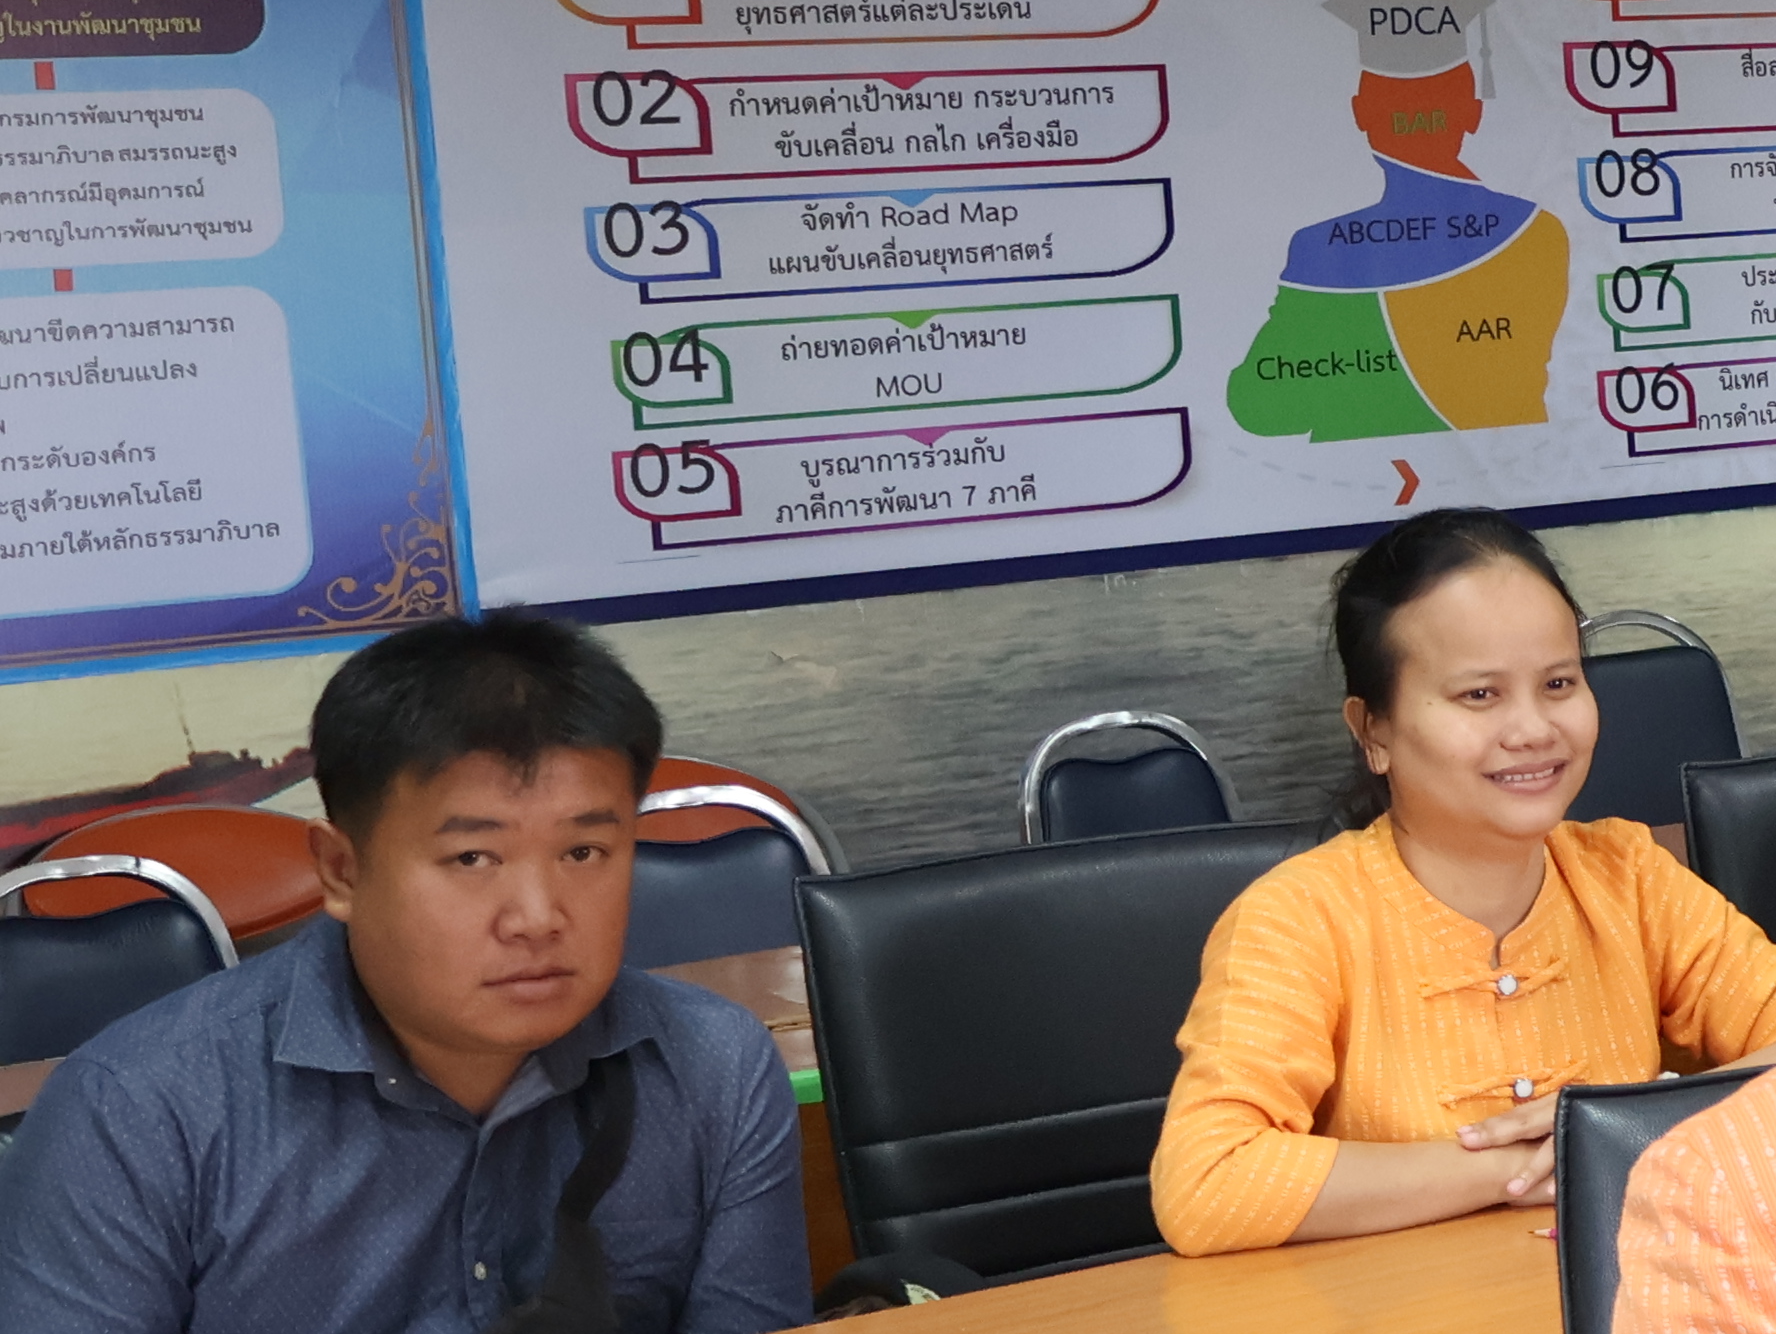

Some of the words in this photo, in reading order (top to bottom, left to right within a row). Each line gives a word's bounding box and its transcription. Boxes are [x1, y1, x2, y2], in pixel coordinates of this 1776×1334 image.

[1369, 6, 1461, 36] PDCA
[1590, 38, 1656, 91] 09
[591, 68, 682, 128] 02
[728, 81, 964, 121] กำหนดค่าเป้าหมาย
[974, 80, 1116, 110] กระบวนการ
[775, 123, 895, 162] ขับเคลื่อน
[904, 124, 967, 156] กลไก
[976, 116, 1079, 152] เครื่องมือ
[1391, 111, 1447, 137] BAR
[1595, 146, 1662, 199] 08
[602, 200, 692, 259] 03
[800, 200, 873, 235] จัดทำ
[880, 199, 951, 229] Road
[959, 199, 1019, 236] Map
[1328, 215, 1438, 247] ABCDEF
[1446, 214, 1501, 242] S&P
[768, 233, 1054, 279] แผนขับเคลื่อนยุทธศาสตร์
[1612, 264, 1676, 316] 07
[780, 320, 1028, 365] ถ่ายทอดค่าเป้าหมาย
[1456, 316, 1513, 344] AAR
[622, 329, 711, 388] 04
[1256, 349, 1398, 382] Check-list
[1718, 360, 1771, 394] นิเทศ
[876, 370, 943, 401] MOU
[1613, 365, 1681, 414] 06
[629, 441, 716, 500] 05
[800, 438, 1006, 488] บูรณาการร่วมกับ
[776, 482, 954, 526] ภาคีการพัฒนา
[962, 485, 977, 509] 7
[987, 474, 1038, 509] ภาคี
